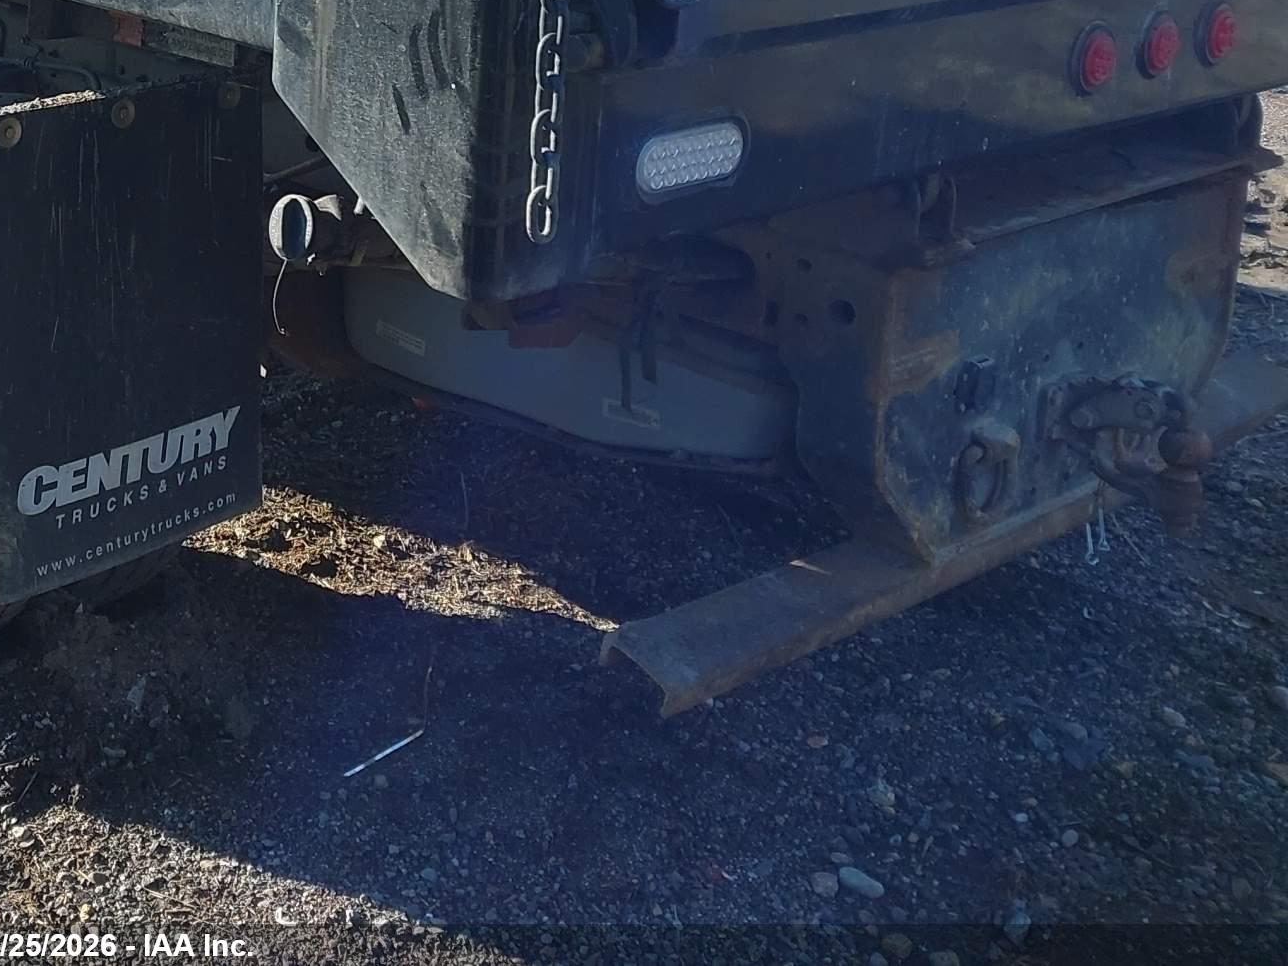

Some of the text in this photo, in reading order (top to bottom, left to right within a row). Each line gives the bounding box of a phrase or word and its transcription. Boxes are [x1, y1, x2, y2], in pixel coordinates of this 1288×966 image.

[17, 405, 241, 516] CENTURY
[55, 455, 228, 530] TRUCKS & VANS
[36, 491, 237, 577] www.centurytrucks.com
